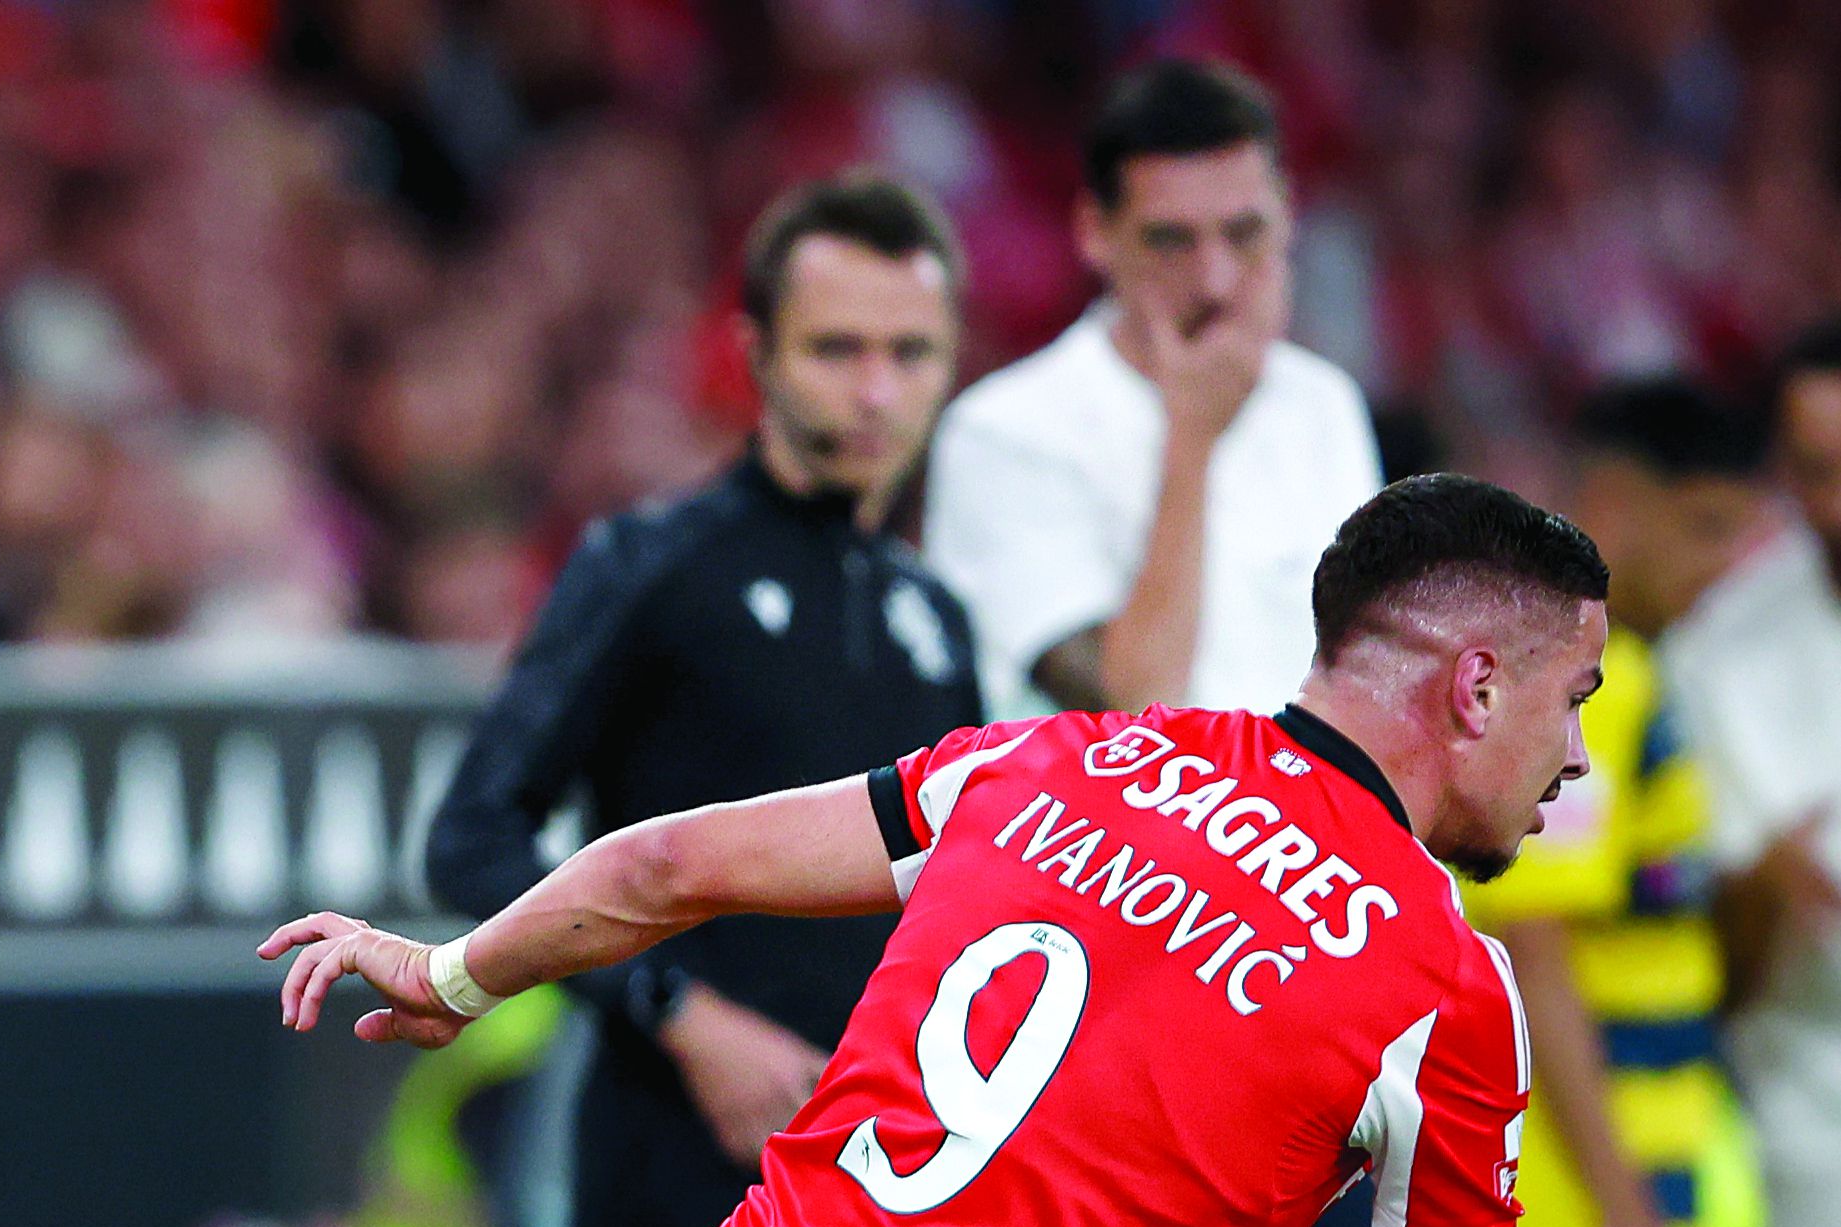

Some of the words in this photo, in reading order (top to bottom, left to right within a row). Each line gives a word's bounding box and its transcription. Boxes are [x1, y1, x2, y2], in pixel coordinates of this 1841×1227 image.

[992, 790, 1308, 1016] IVANOVIĆ
[1122, 754, 1399, 959] SAGRES
[835, 921, 1090, 1214] 9
